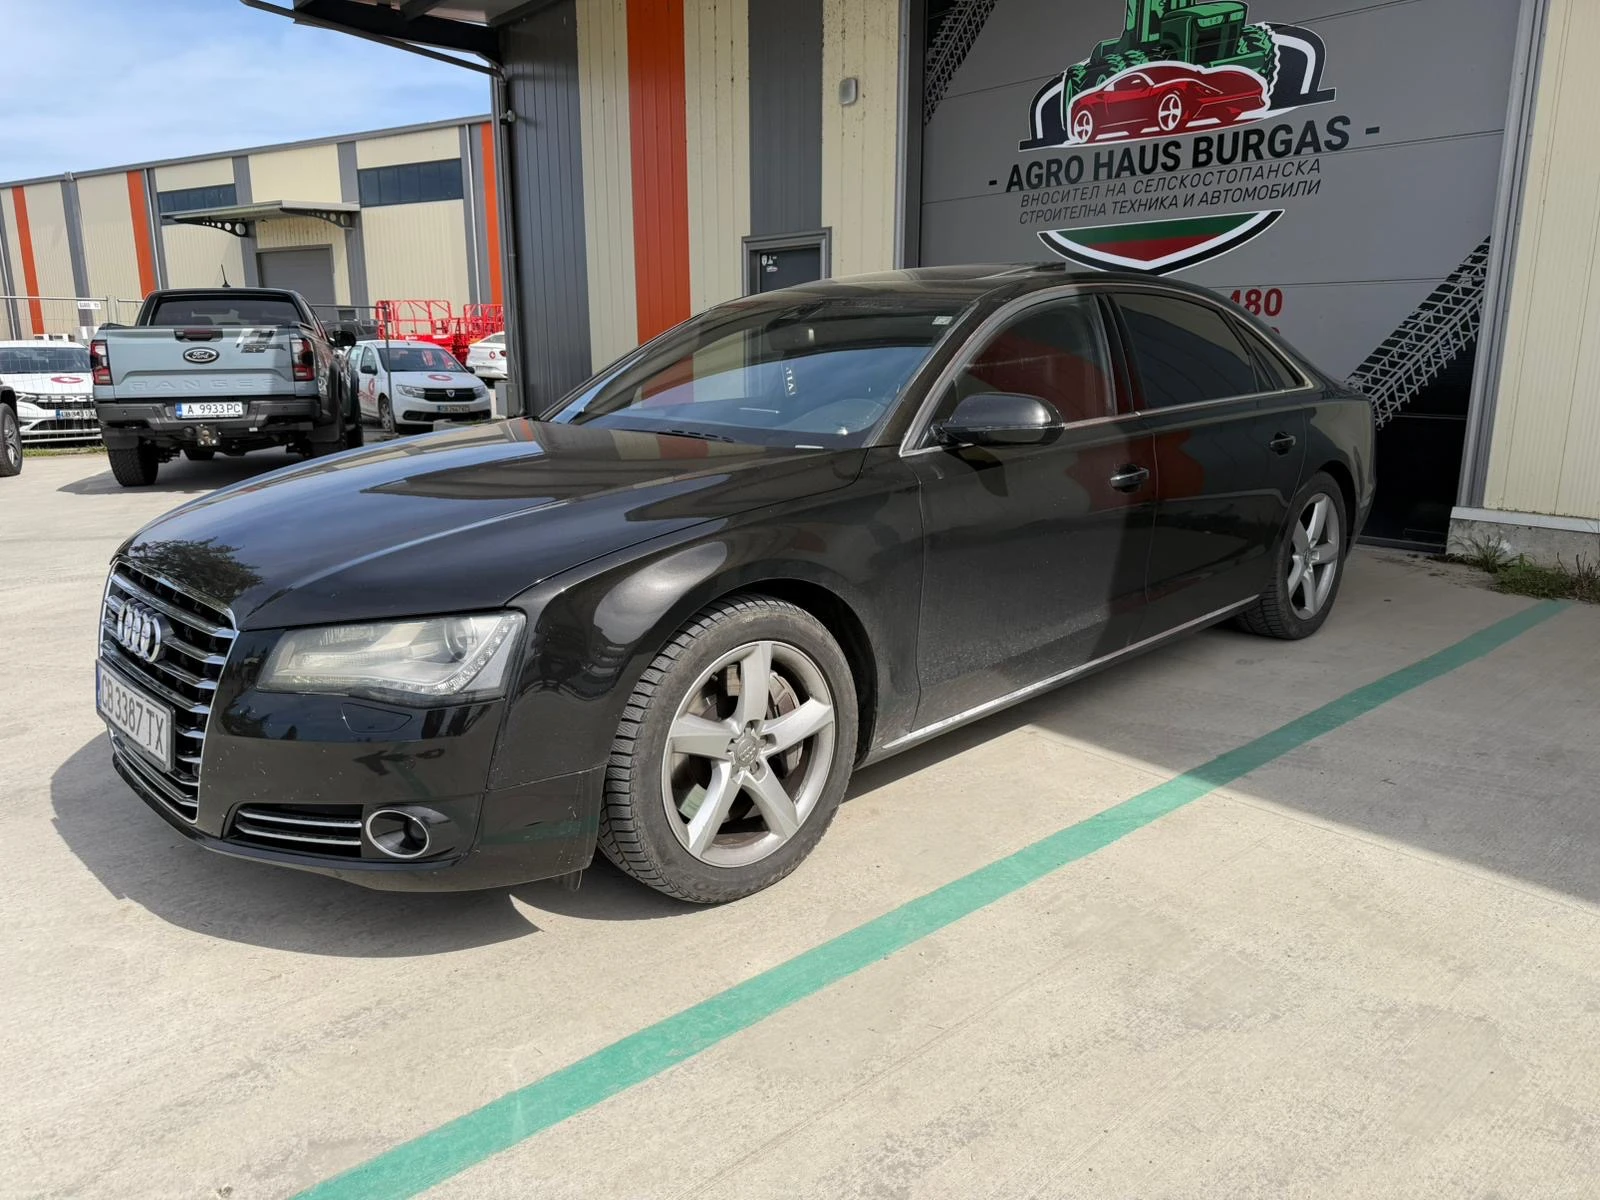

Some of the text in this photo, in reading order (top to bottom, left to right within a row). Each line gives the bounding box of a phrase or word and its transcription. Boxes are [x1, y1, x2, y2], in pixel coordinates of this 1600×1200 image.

[1005, 155, 1084, 192] AGRO
[1093, 140, 1181, 181] HAUS
[1192, 115, 1351, 168] BURGAS
[1019, 179, 1321, 224] СТРОИТЕЛНА ТЕХНИКА И АВТОМОБИЛИ
[1020, 158, 1320, 208] ВНОСИТЕЛ НА СЕЛСКОСТОПАНСКА
[191, 351, 210, 360] Ford
